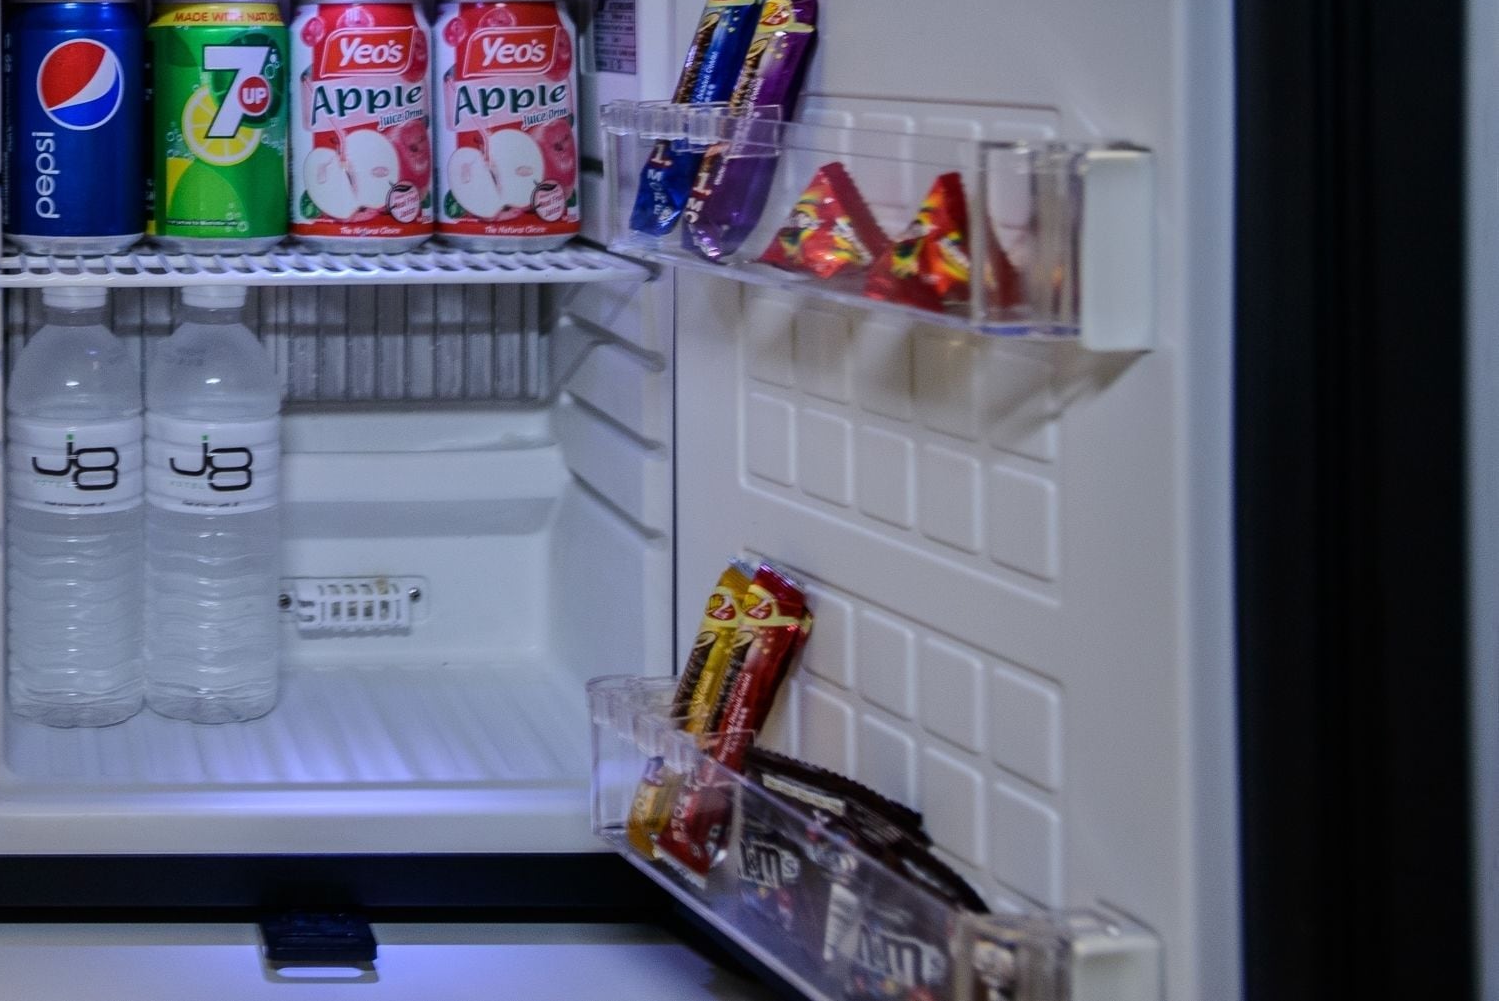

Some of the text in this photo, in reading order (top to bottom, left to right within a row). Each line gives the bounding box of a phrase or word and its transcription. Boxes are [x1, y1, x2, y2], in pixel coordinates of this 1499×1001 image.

[173, 11, 209, 22] MADE
[338, 36, 403, 68] Yeo's
[481, 36, 546, 68] Yeo's
[203, 44, 273, 140] 7
[241, 86, 268, 107] UP
[311, 81, 424, 127] Apple
[455, 81, 568, 127] Apple
[35, 131, 61, 220] pepsi
